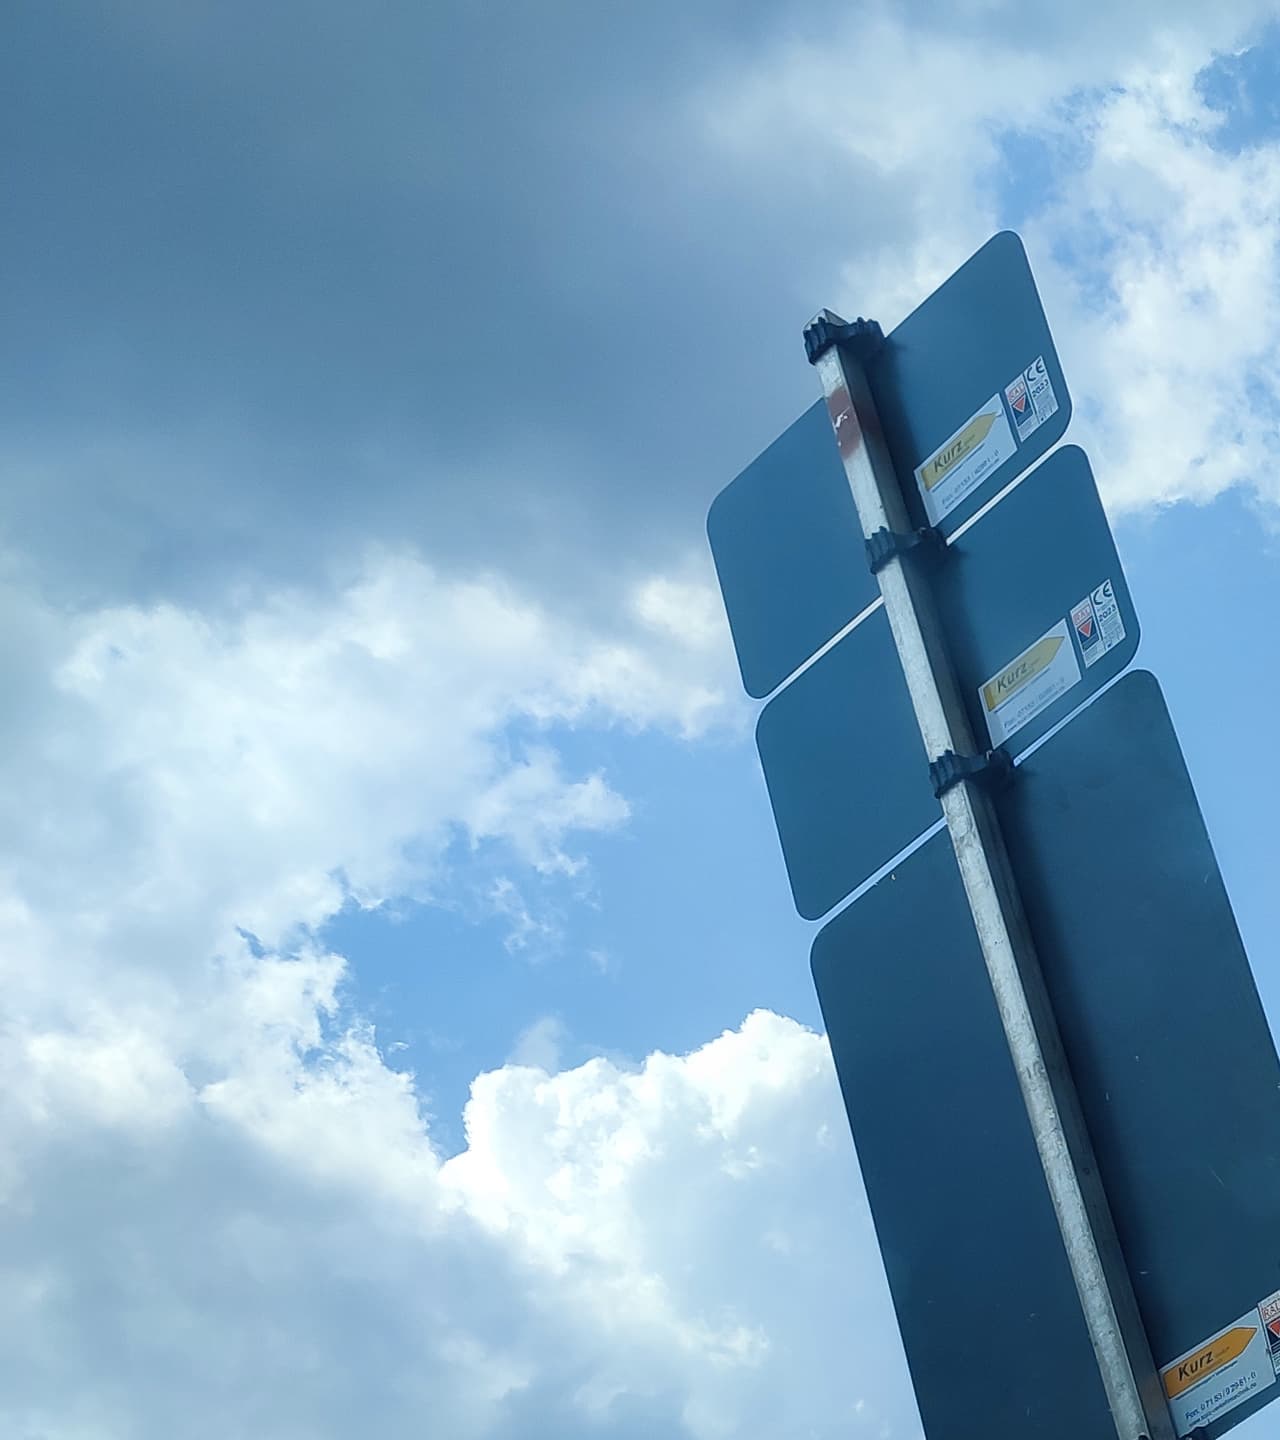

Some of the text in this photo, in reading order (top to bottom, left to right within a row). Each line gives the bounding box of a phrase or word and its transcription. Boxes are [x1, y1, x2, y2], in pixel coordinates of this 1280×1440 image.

[933, 440, 964, 473] Kurz
[996, 661, 1027, 694] Kurz
[1178, 1351, 1214, 1381] Kurz
